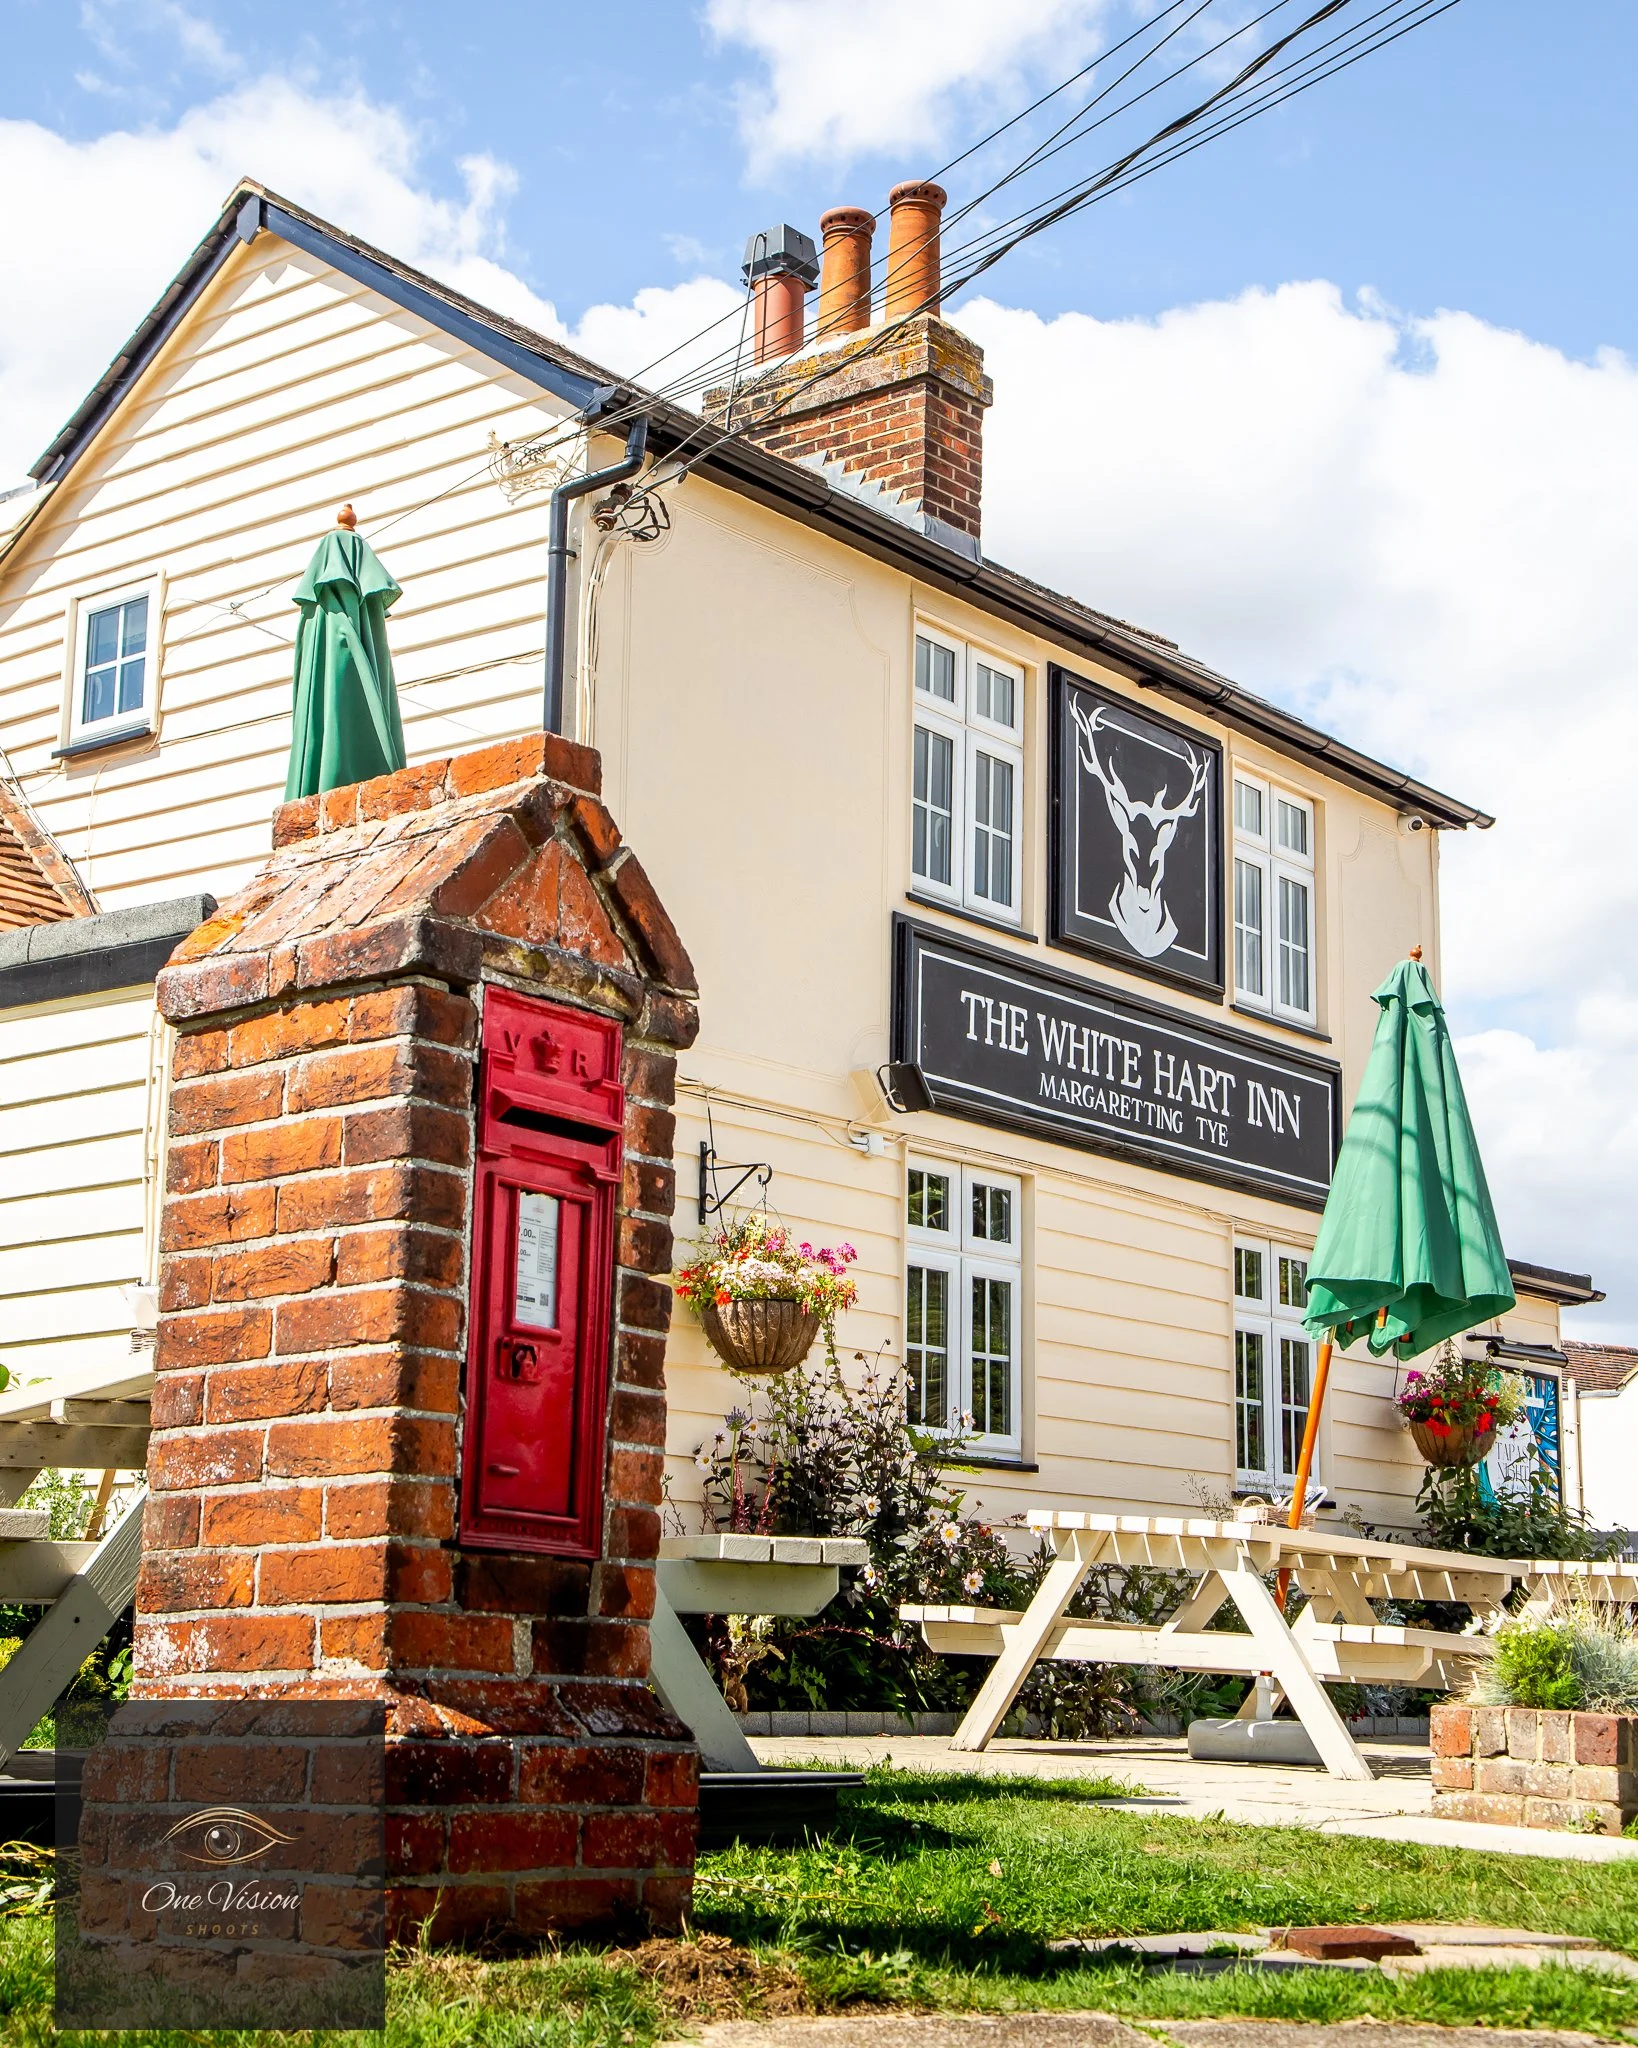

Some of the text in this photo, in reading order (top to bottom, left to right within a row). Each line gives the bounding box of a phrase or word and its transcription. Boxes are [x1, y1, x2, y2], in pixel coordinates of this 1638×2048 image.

[503, 1029, 589, 1078] V R
[961, 990, 1300, 1139] THE WHITE HART INN
[1039, 1072, 1229, 1147] MARGARETTING TYE
